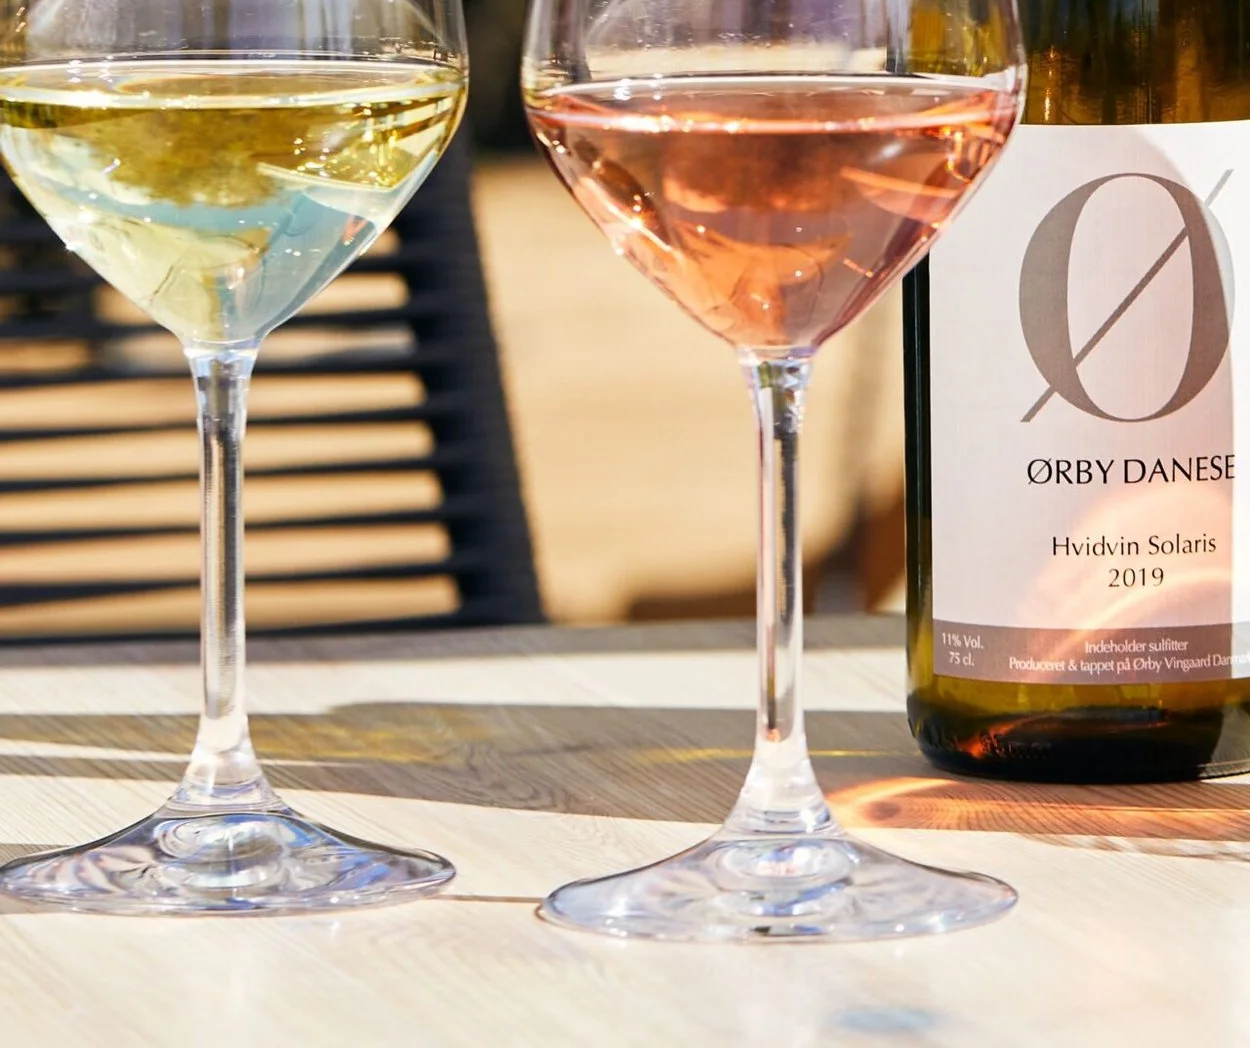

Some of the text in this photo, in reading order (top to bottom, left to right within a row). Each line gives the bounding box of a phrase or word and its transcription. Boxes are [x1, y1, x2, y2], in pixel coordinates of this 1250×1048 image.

[1019, 168, 1235, 423] Ø
[1027, 454, 1235, 485] ØRBY DANESE
[1052, 533, 1217, 556] Hvidvin Solaris
[1108, 567, 1164, 588] 2019
[942, 632, 984, 650] 11% Vol.
[1085, 637, 1188, 654] Indeholder sulfitter
[949, 651, 975, 666] 75 cl.
[1009, 656, 1065, 672] Produceret
[1067, 658, 1078, 672] &
[1080, 659, 1114, 675] tappet
[1117, 658, 1131, 674] på
[1133, 656, 1162, 673] Ørby
[1164, 654, 1211, 672] Vingaard
